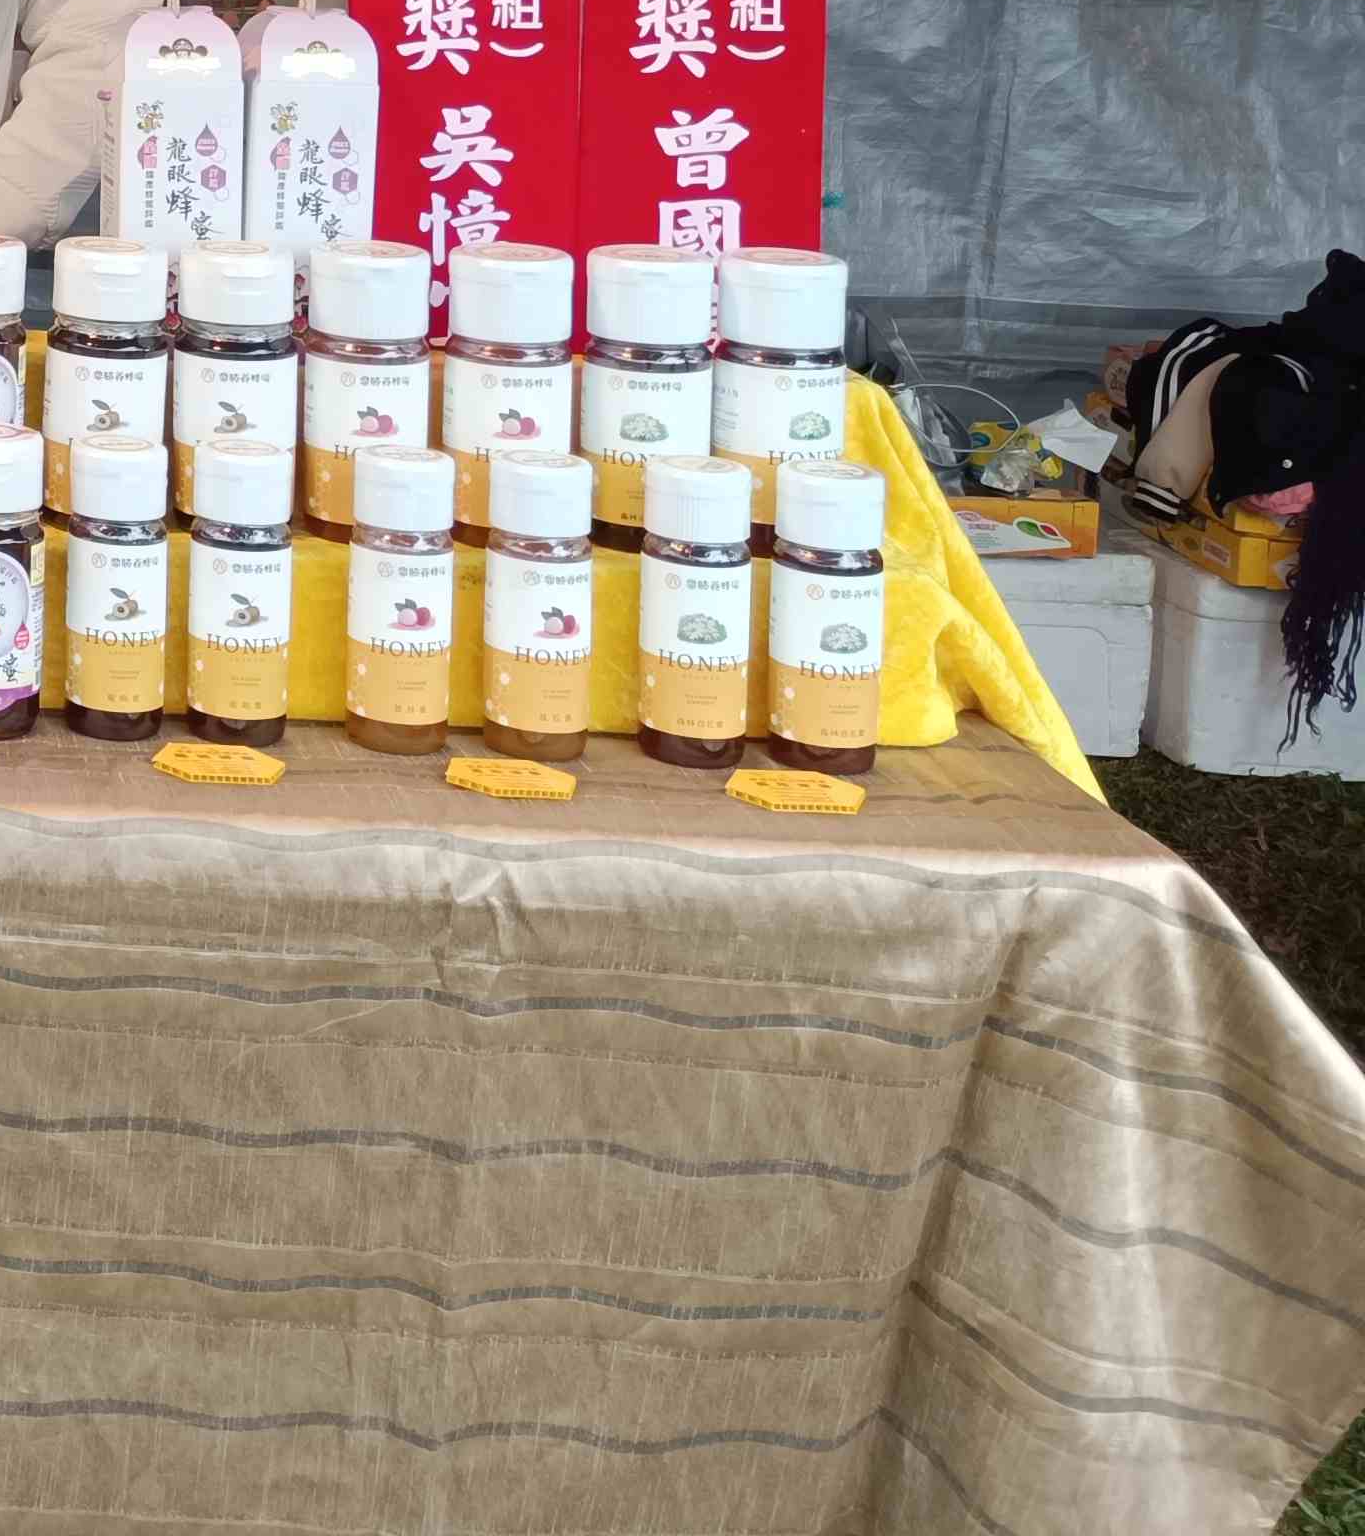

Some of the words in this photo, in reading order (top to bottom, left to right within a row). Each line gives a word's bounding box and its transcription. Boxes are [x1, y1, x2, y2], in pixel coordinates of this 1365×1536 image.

[654, 107, 751, 296] 曾國
[602, 446, 655, 469] HON
[84, 627, 162, 648] HONEY
[205, 633, 283, 655] HONEY
[370, 636, 448, 659] HONEY
[514, 645, 590, 666] HONEY
[658, 648, 743, 673] HONEY
[798, 659, 880, 682] HONEY
